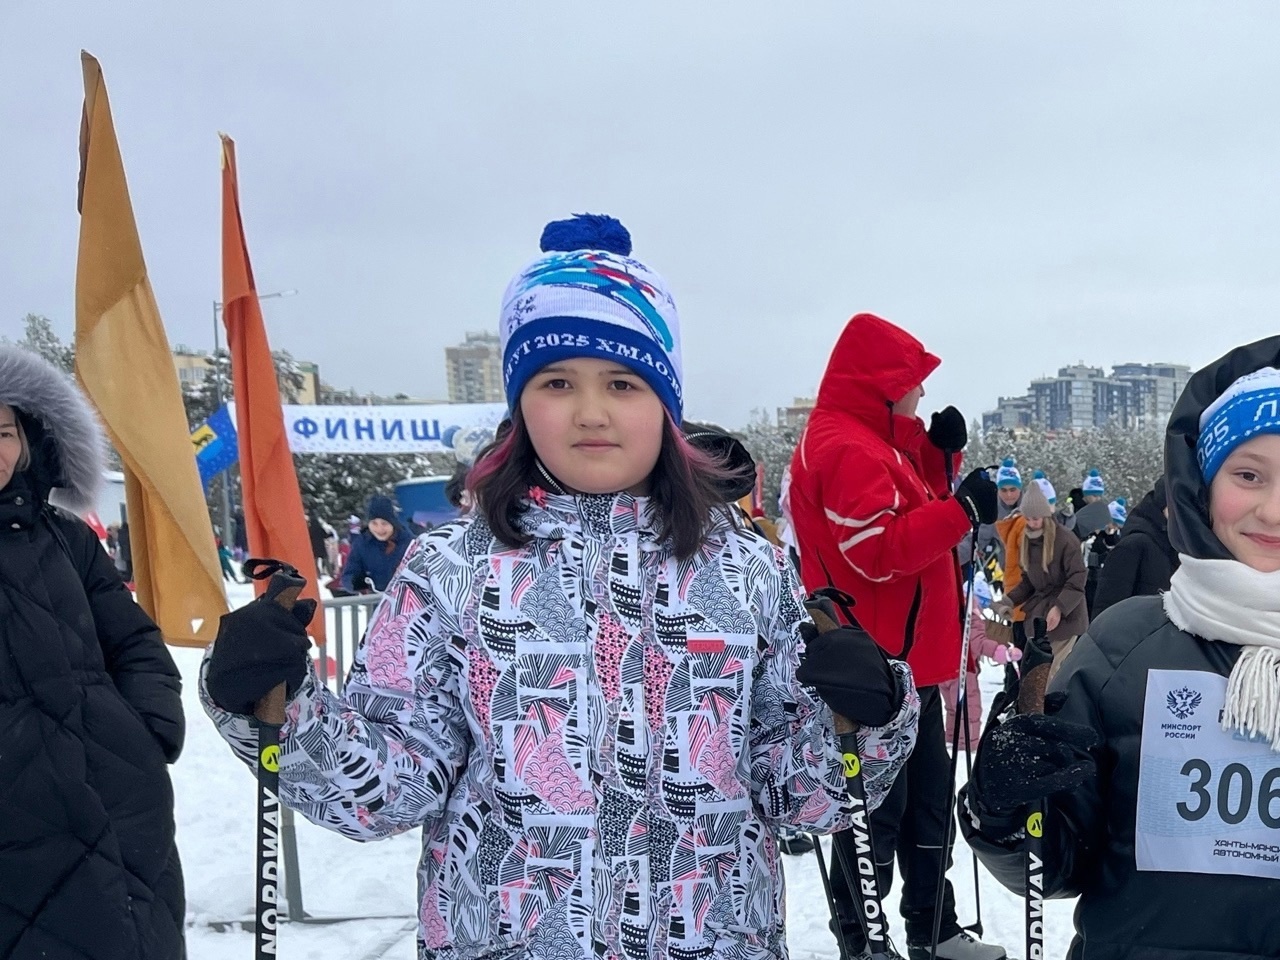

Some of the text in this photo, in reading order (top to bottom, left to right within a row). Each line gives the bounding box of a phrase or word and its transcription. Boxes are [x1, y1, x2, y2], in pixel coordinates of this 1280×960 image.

[534, 333, 590, 349] 2025
[293, 416, 441, 441] ФИНИШ
[1197, 417, 1230, 470] 025
[1161, 723, 1201, 732] МИНСПОРТ
[1164, 732, 1196, 740] РОССИИ
[1213, 849, 1279, 863] АВТОНОМНЫЙ
[850, 793, 884, 942] NORDWAY
